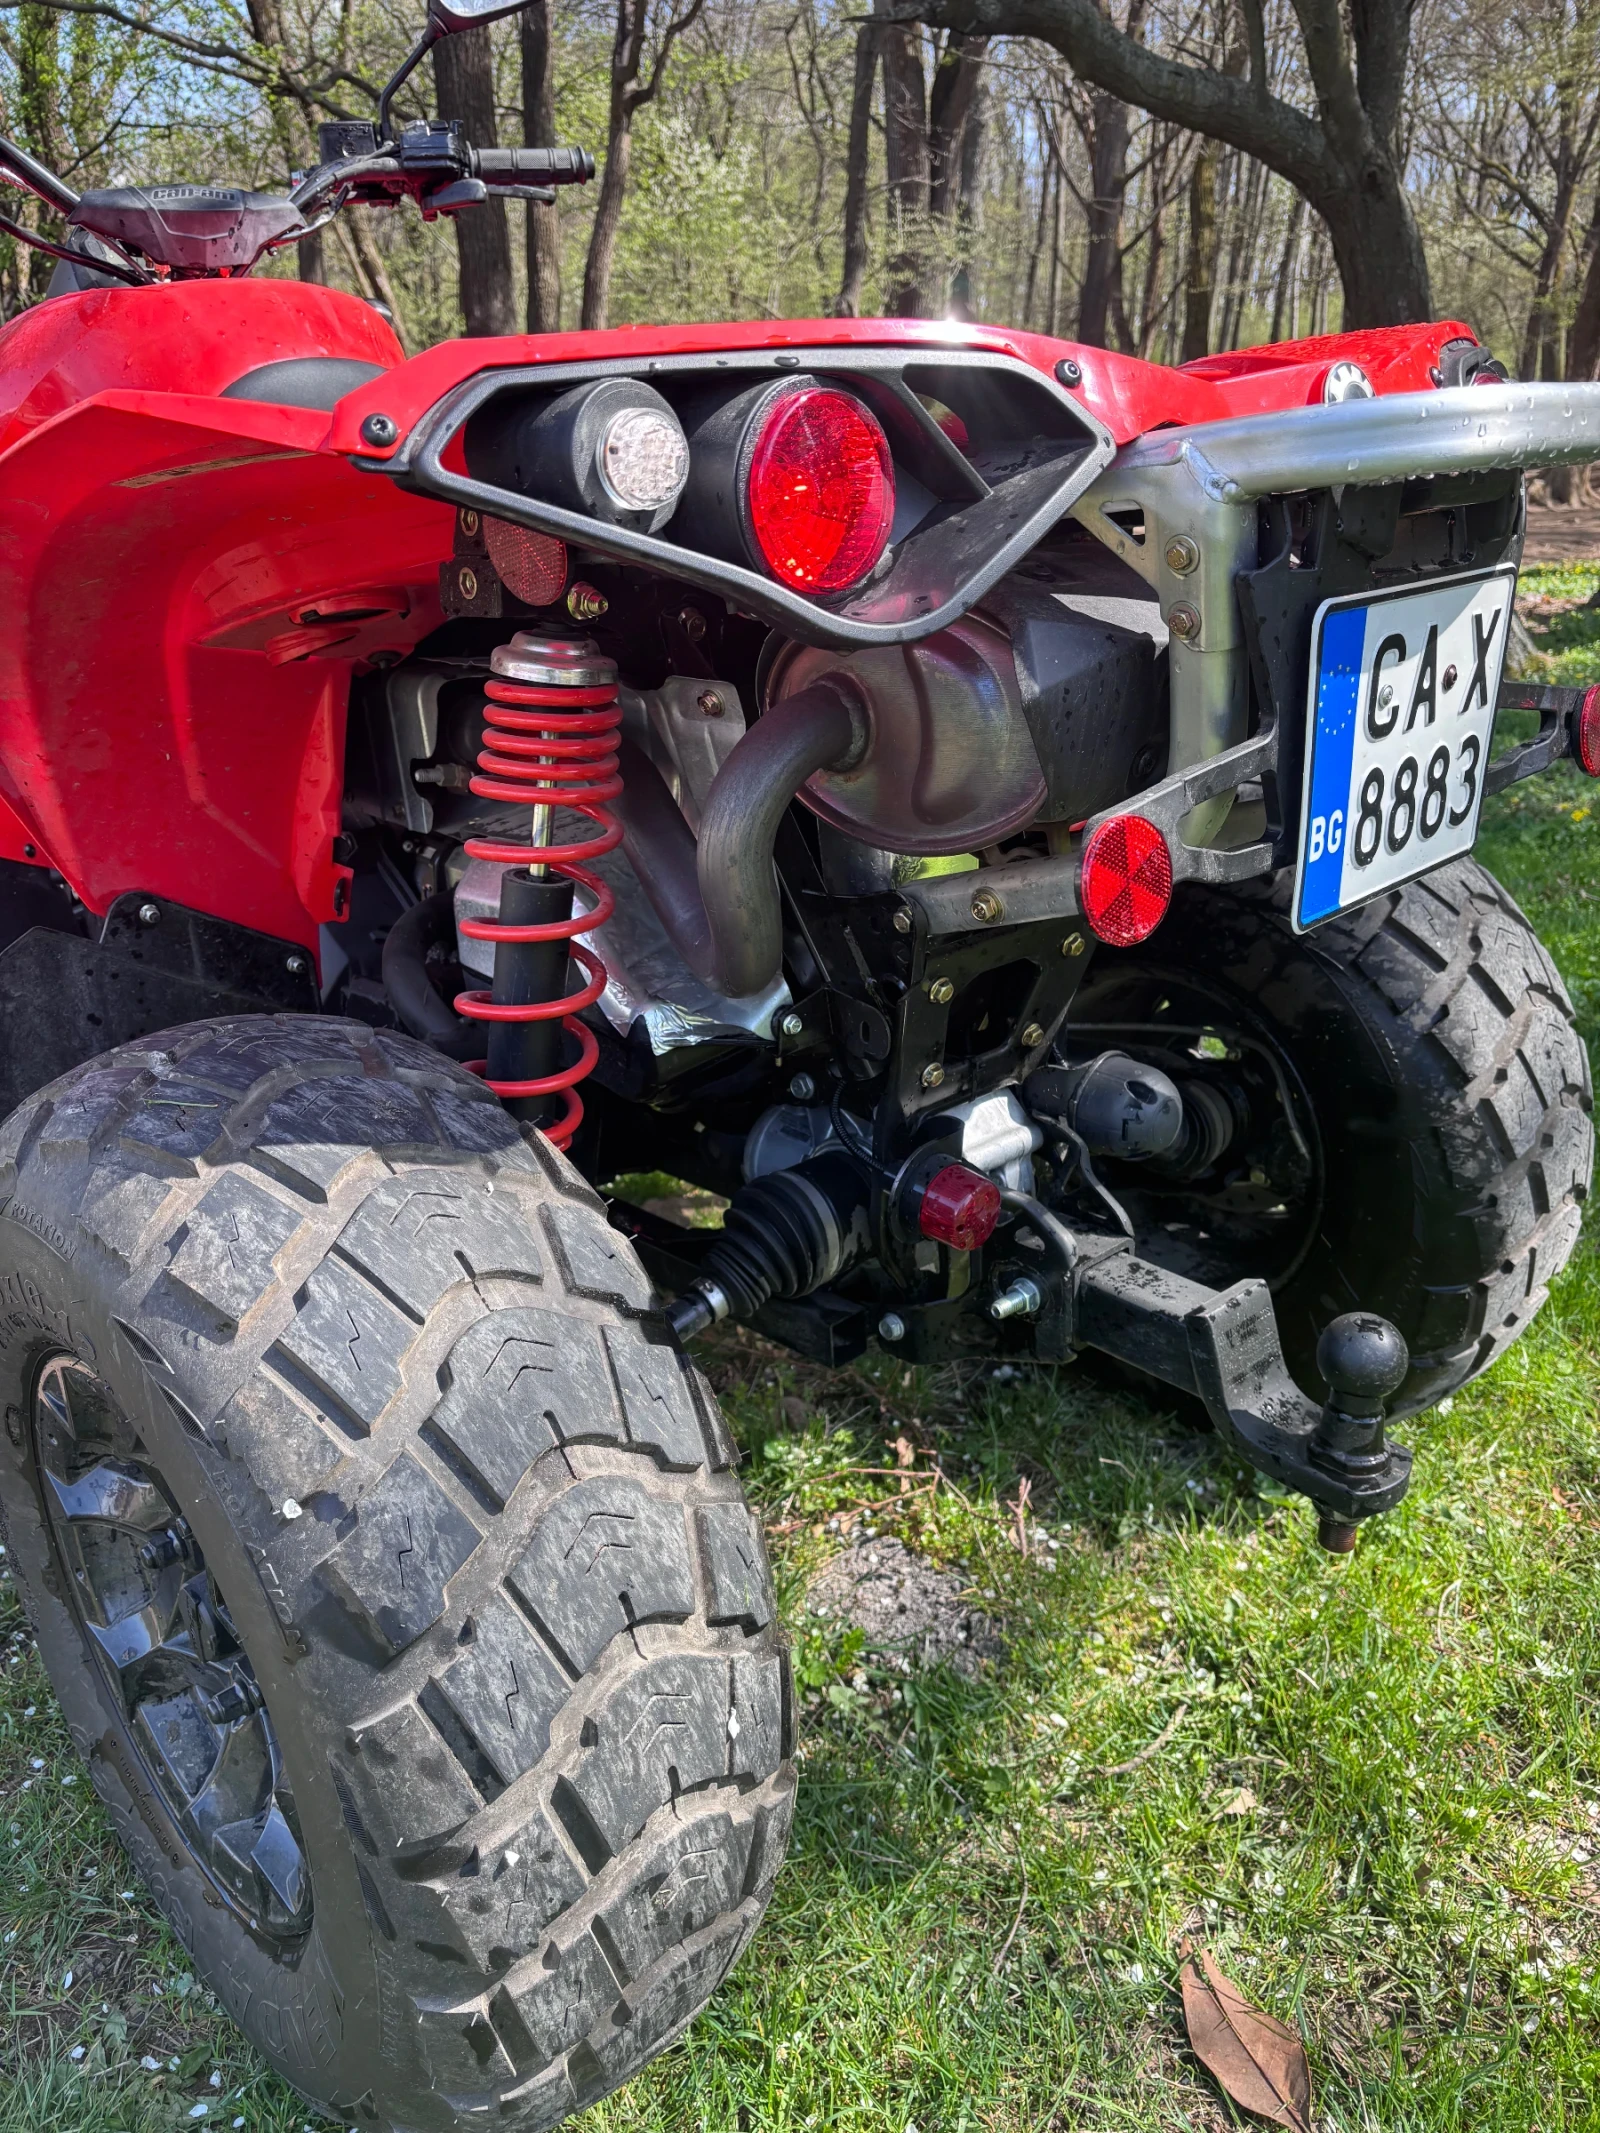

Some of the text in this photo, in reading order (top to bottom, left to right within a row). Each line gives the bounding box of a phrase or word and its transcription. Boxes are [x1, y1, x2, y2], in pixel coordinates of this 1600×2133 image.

[152, 187, 236, 201] can-am
[1366, 607, 1502, 740] CA X
[1354, 734, 1480, 867] 8883
[1309, 810, 1343, 863] BG
[10, 1201, 77, 1260] ROTATION
